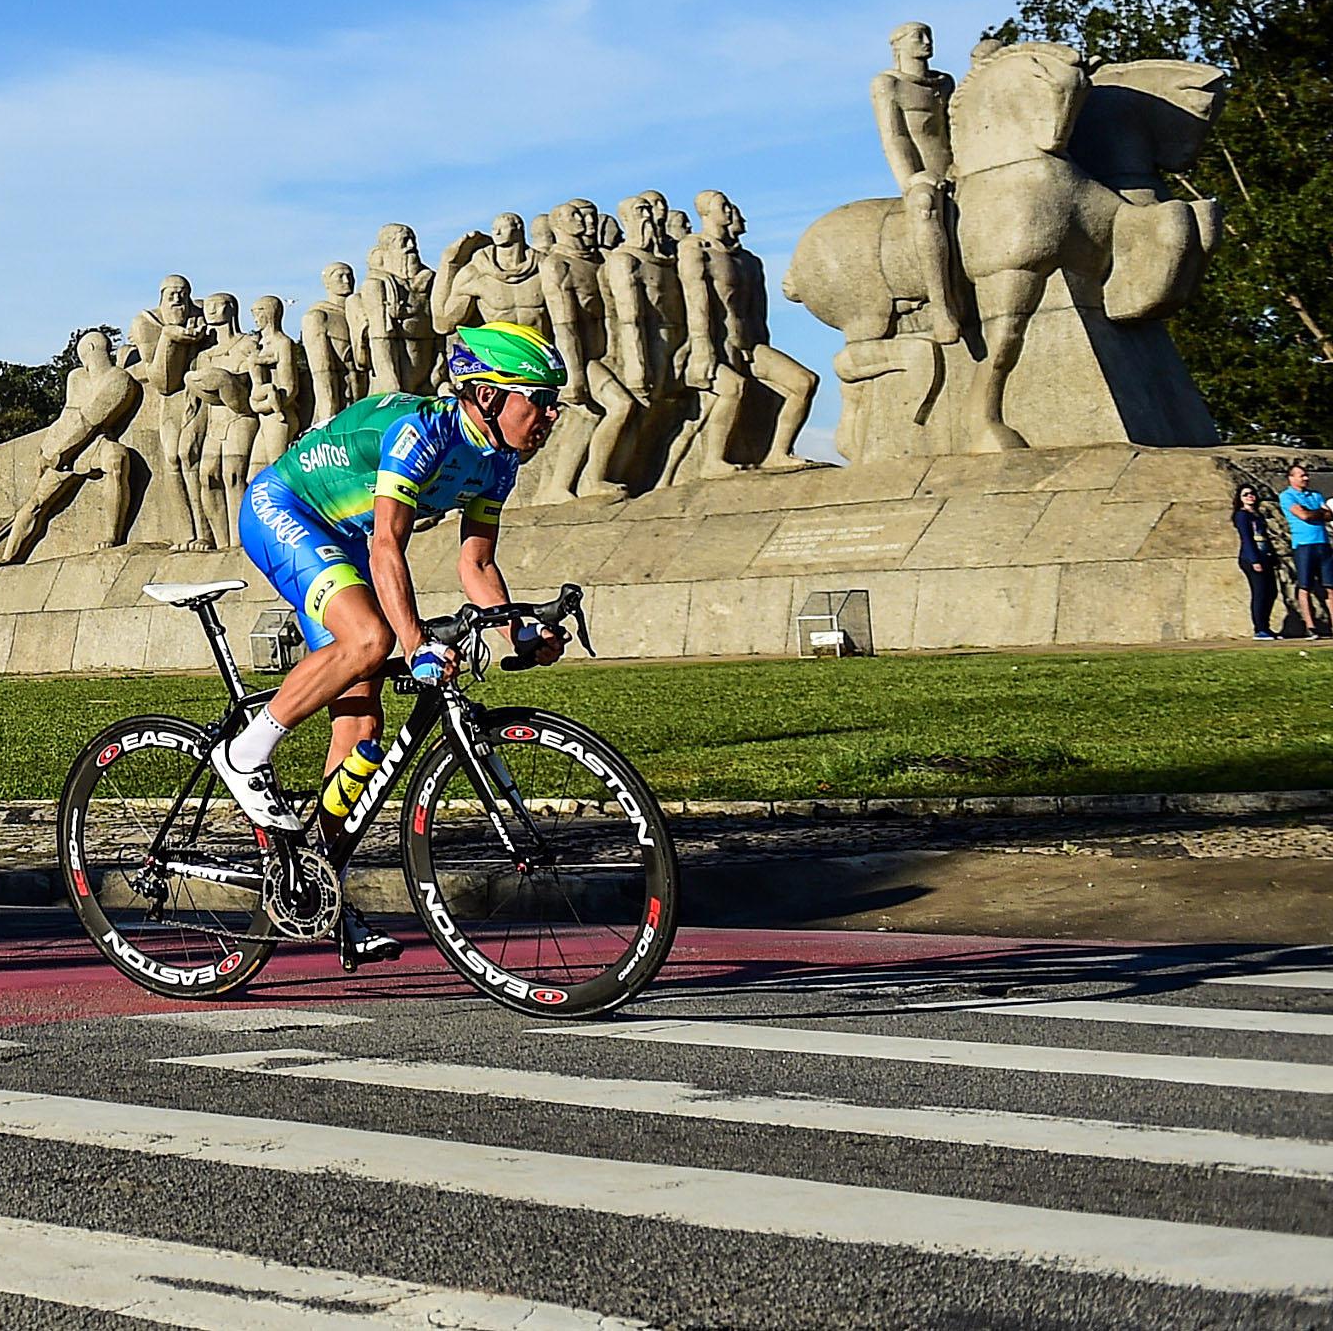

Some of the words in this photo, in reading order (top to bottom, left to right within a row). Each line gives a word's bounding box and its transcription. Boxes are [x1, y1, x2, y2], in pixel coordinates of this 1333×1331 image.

[299, 443, 351, 473] SANTOS
[251, 481, 310, 549] MEMORIAL
[344, 724, 412, 834] GIANT
[539, 729, 655, 847] EASTON
[489, 811, 516, 853] GIANT
[102, 930, 217, 986] EASTON
[419, 881, 531, 1000] EASTON
